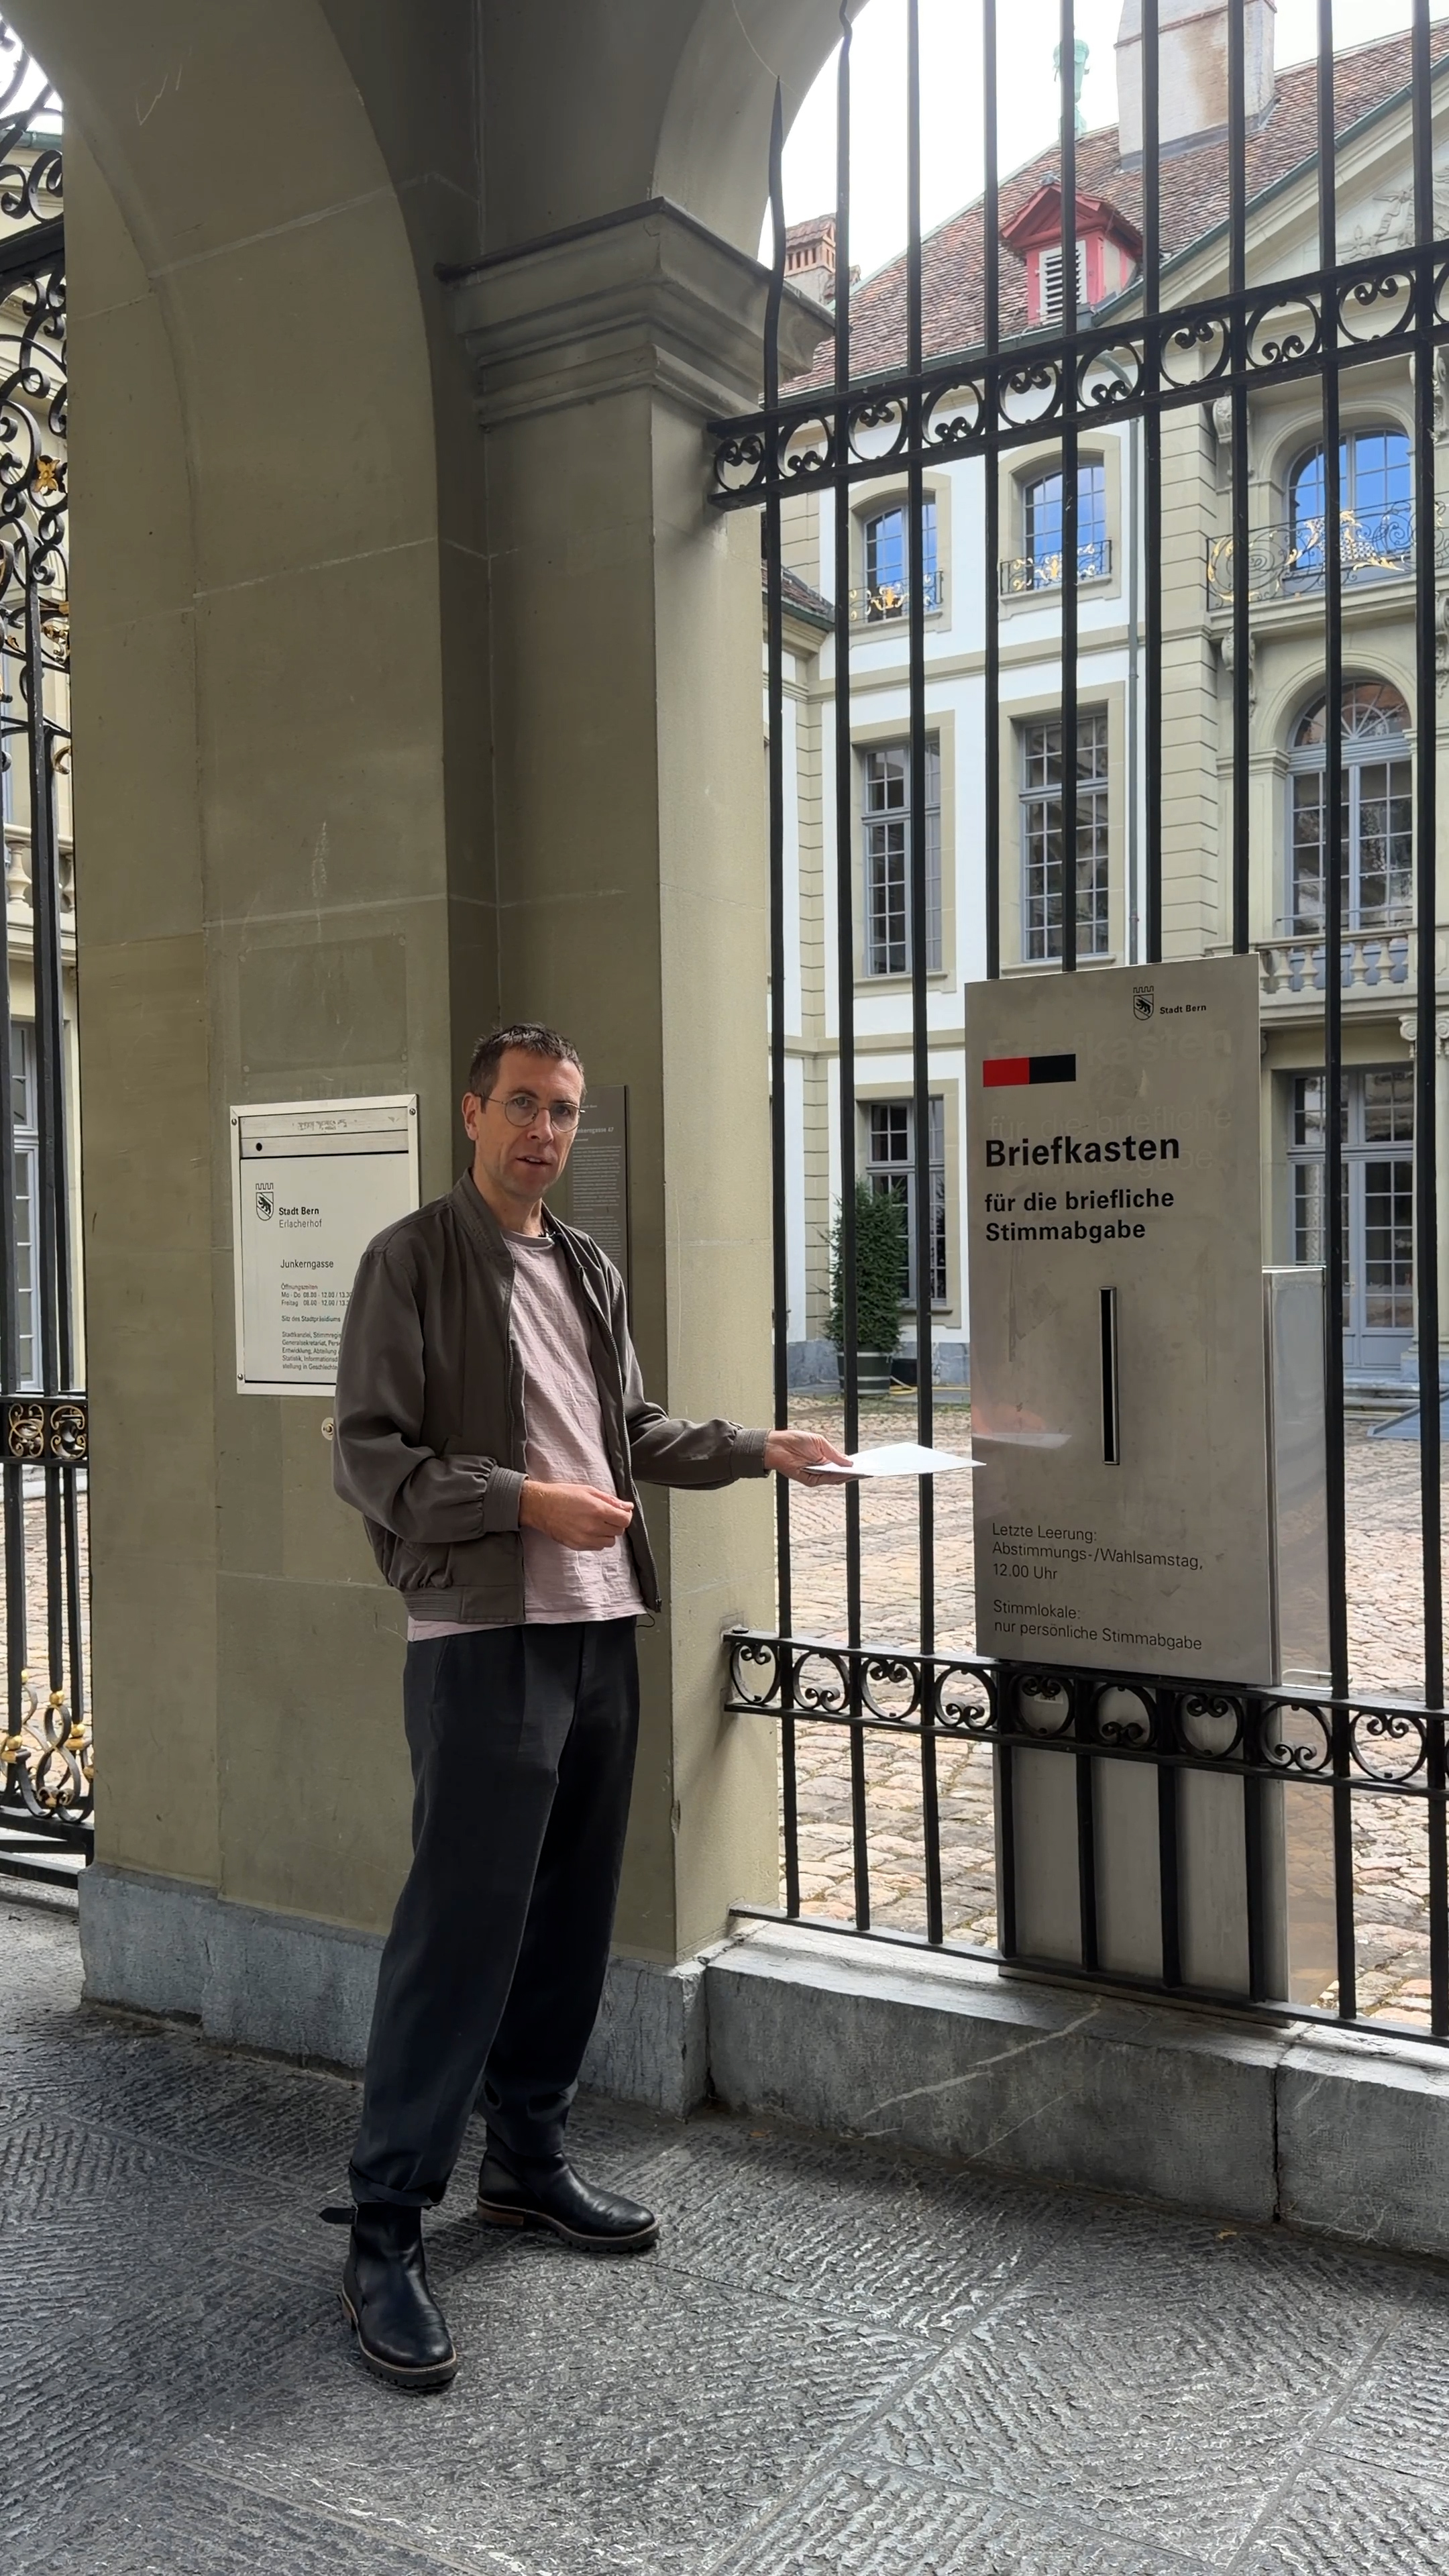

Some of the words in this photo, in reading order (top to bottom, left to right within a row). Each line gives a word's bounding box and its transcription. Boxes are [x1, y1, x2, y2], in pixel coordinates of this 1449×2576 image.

[1159, 1005, 1183, 1015] Stadt
[1185, 1004, 1207, 1013] Bern
[985, 1135, 1181, 1168] Briefkasten
[984, 1192, 1016, 1213] für
[1023, 1191, 1057, 1212] die
[1065, 1188, 1175, 1210] briefliche
[278, 1207, 299, 1216] Stadt
[301, 1206, 319, 1215] Bern
[279, 1218, 322, 1228] Erlacherhof
[985, 1220, 1146, 1244] Stimmabgabe
[280, 1259, 334, 1270] Junkerngasse
[301, 1315, 341, 1323] Stadtpräsidiums
[992, 1523, 1033, 1538] Letzte
[1038, 1524, 1097, 1544] Leerung:
[993, 1563, 1029, 1578] 12.00
[1033, 1565, 1057, 1580] Uhr
[993, 1600, 1081, 1620] Stimmlokale:
[994, 1620, 1016, 1633] nur
[1020, 1623, 1098, 1642] persönliche
[1102, 1628, 1202, 1651] Stimmabgabe
